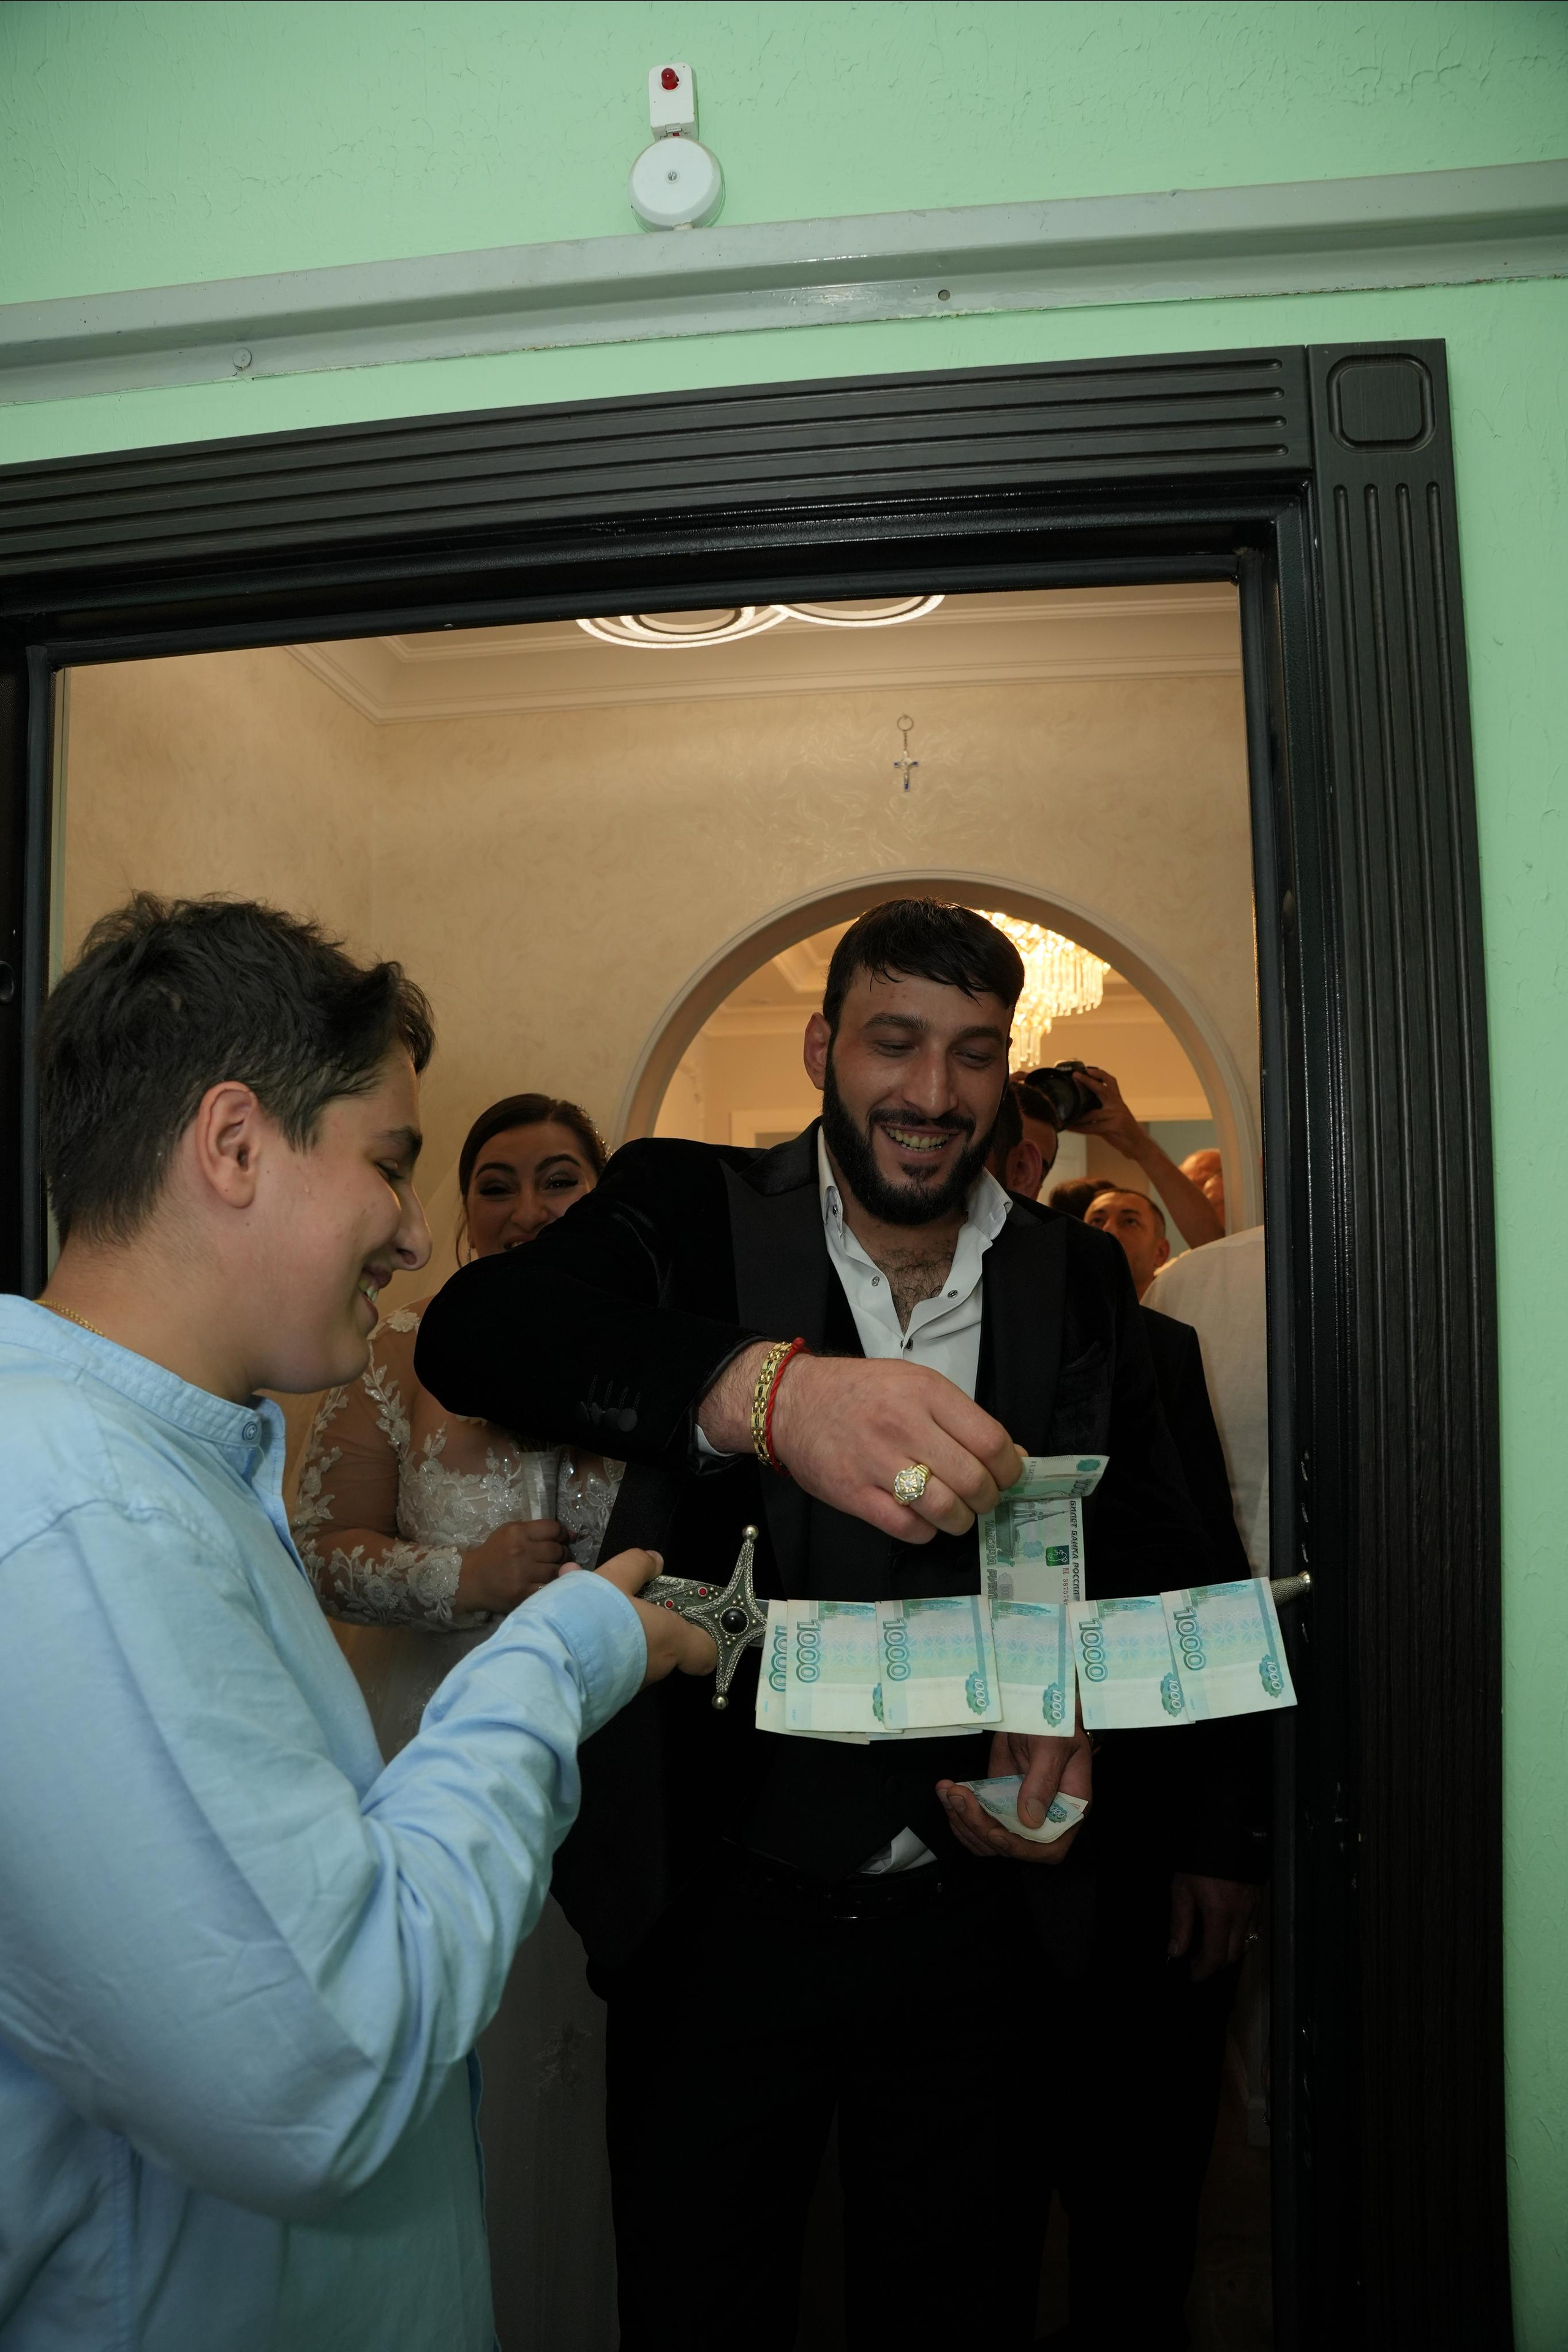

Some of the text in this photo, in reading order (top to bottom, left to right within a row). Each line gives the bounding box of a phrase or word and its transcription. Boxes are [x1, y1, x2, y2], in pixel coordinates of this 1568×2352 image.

[1069, 1501, 1078, 1528] БИЛЕТ
[987, 1569, 998, 1599] РУБЛ
[796, 1619, 821, 1683] 1000
[883, 1617, 911, 1681] 1000
[1079, 1618, 1108, 1682] 1000
[1174, 1606, 1207, 1671] 1000
[1267, 1660, 1282, 1691] 1000
[974, 1678, 986, 1707] 1000
[1051, 1691, 1062, 1720] 1000
[1169, 1679, 1182, 1709] 1000
